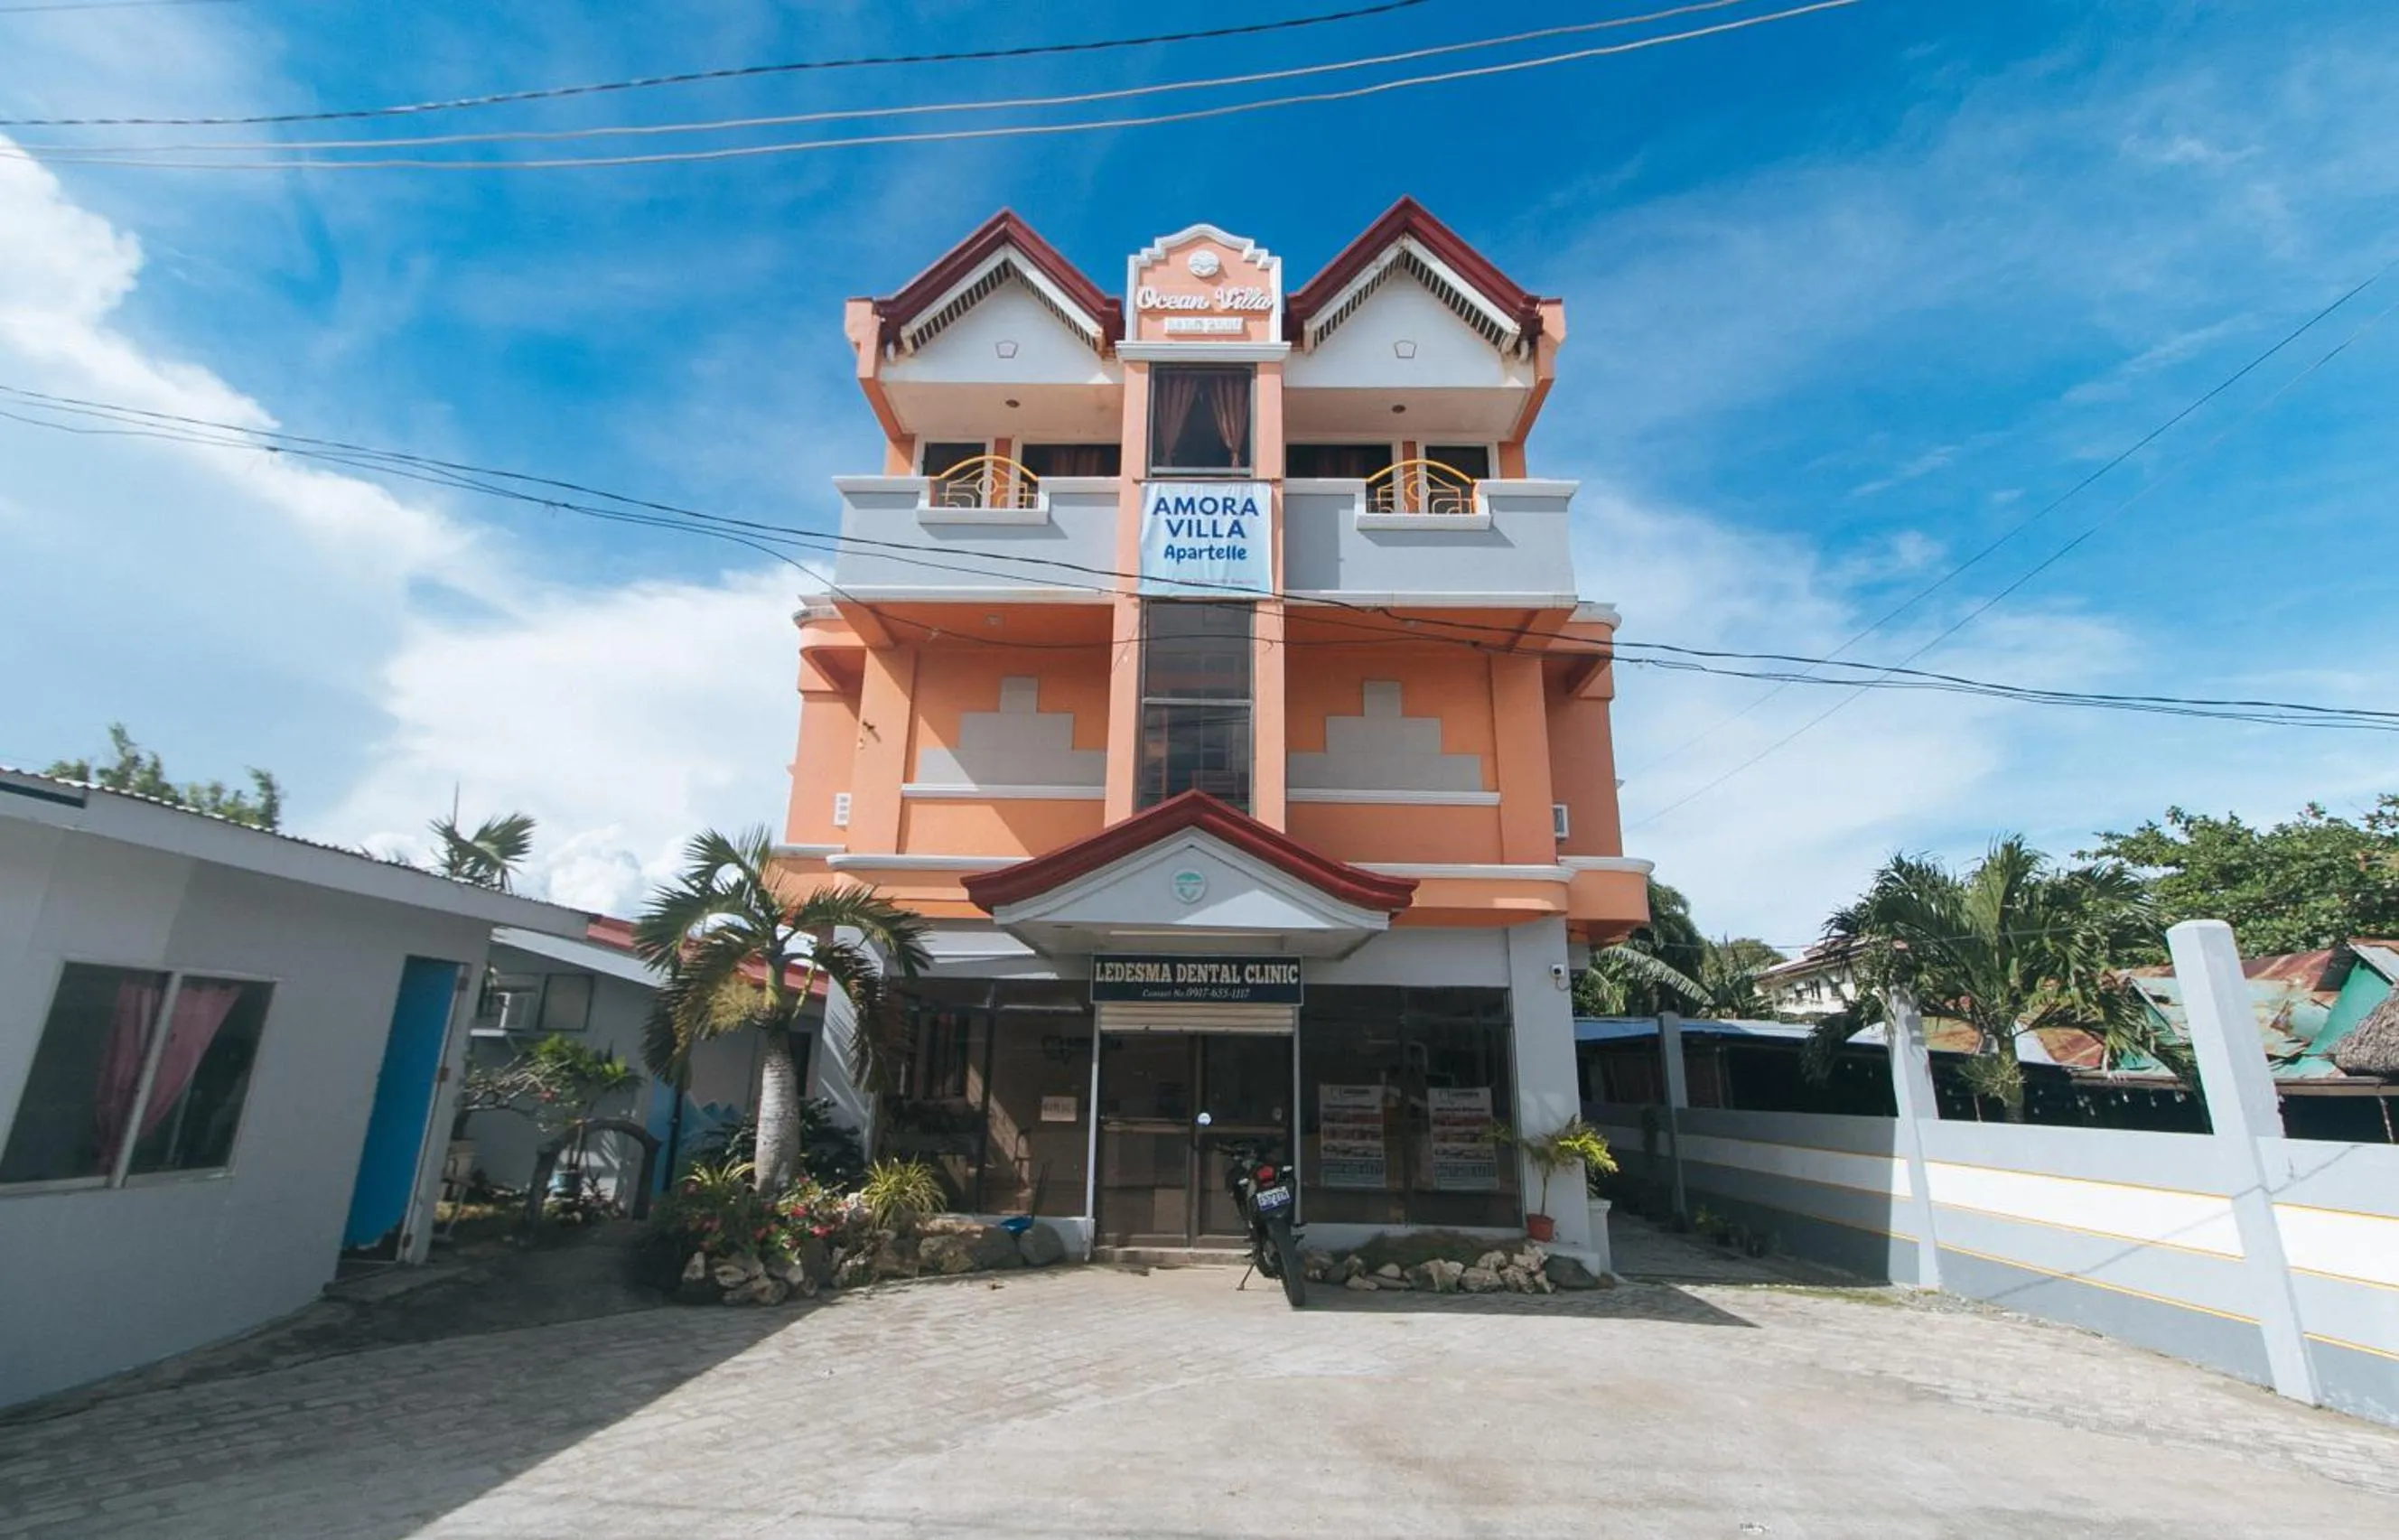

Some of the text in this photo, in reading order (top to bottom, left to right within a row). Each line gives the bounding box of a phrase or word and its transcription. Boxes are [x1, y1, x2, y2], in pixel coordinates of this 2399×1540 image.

[1136, 286, 1274, 311] Ocean Villa
[1153, 496, 1260, 517] AMORA
[1165, 518, 1246, 538] VILLA
[1163, 544, 1247, 565] Apartelle
[1095, 962, 1299, 985] LEDESMA DENTAL CLINIC
